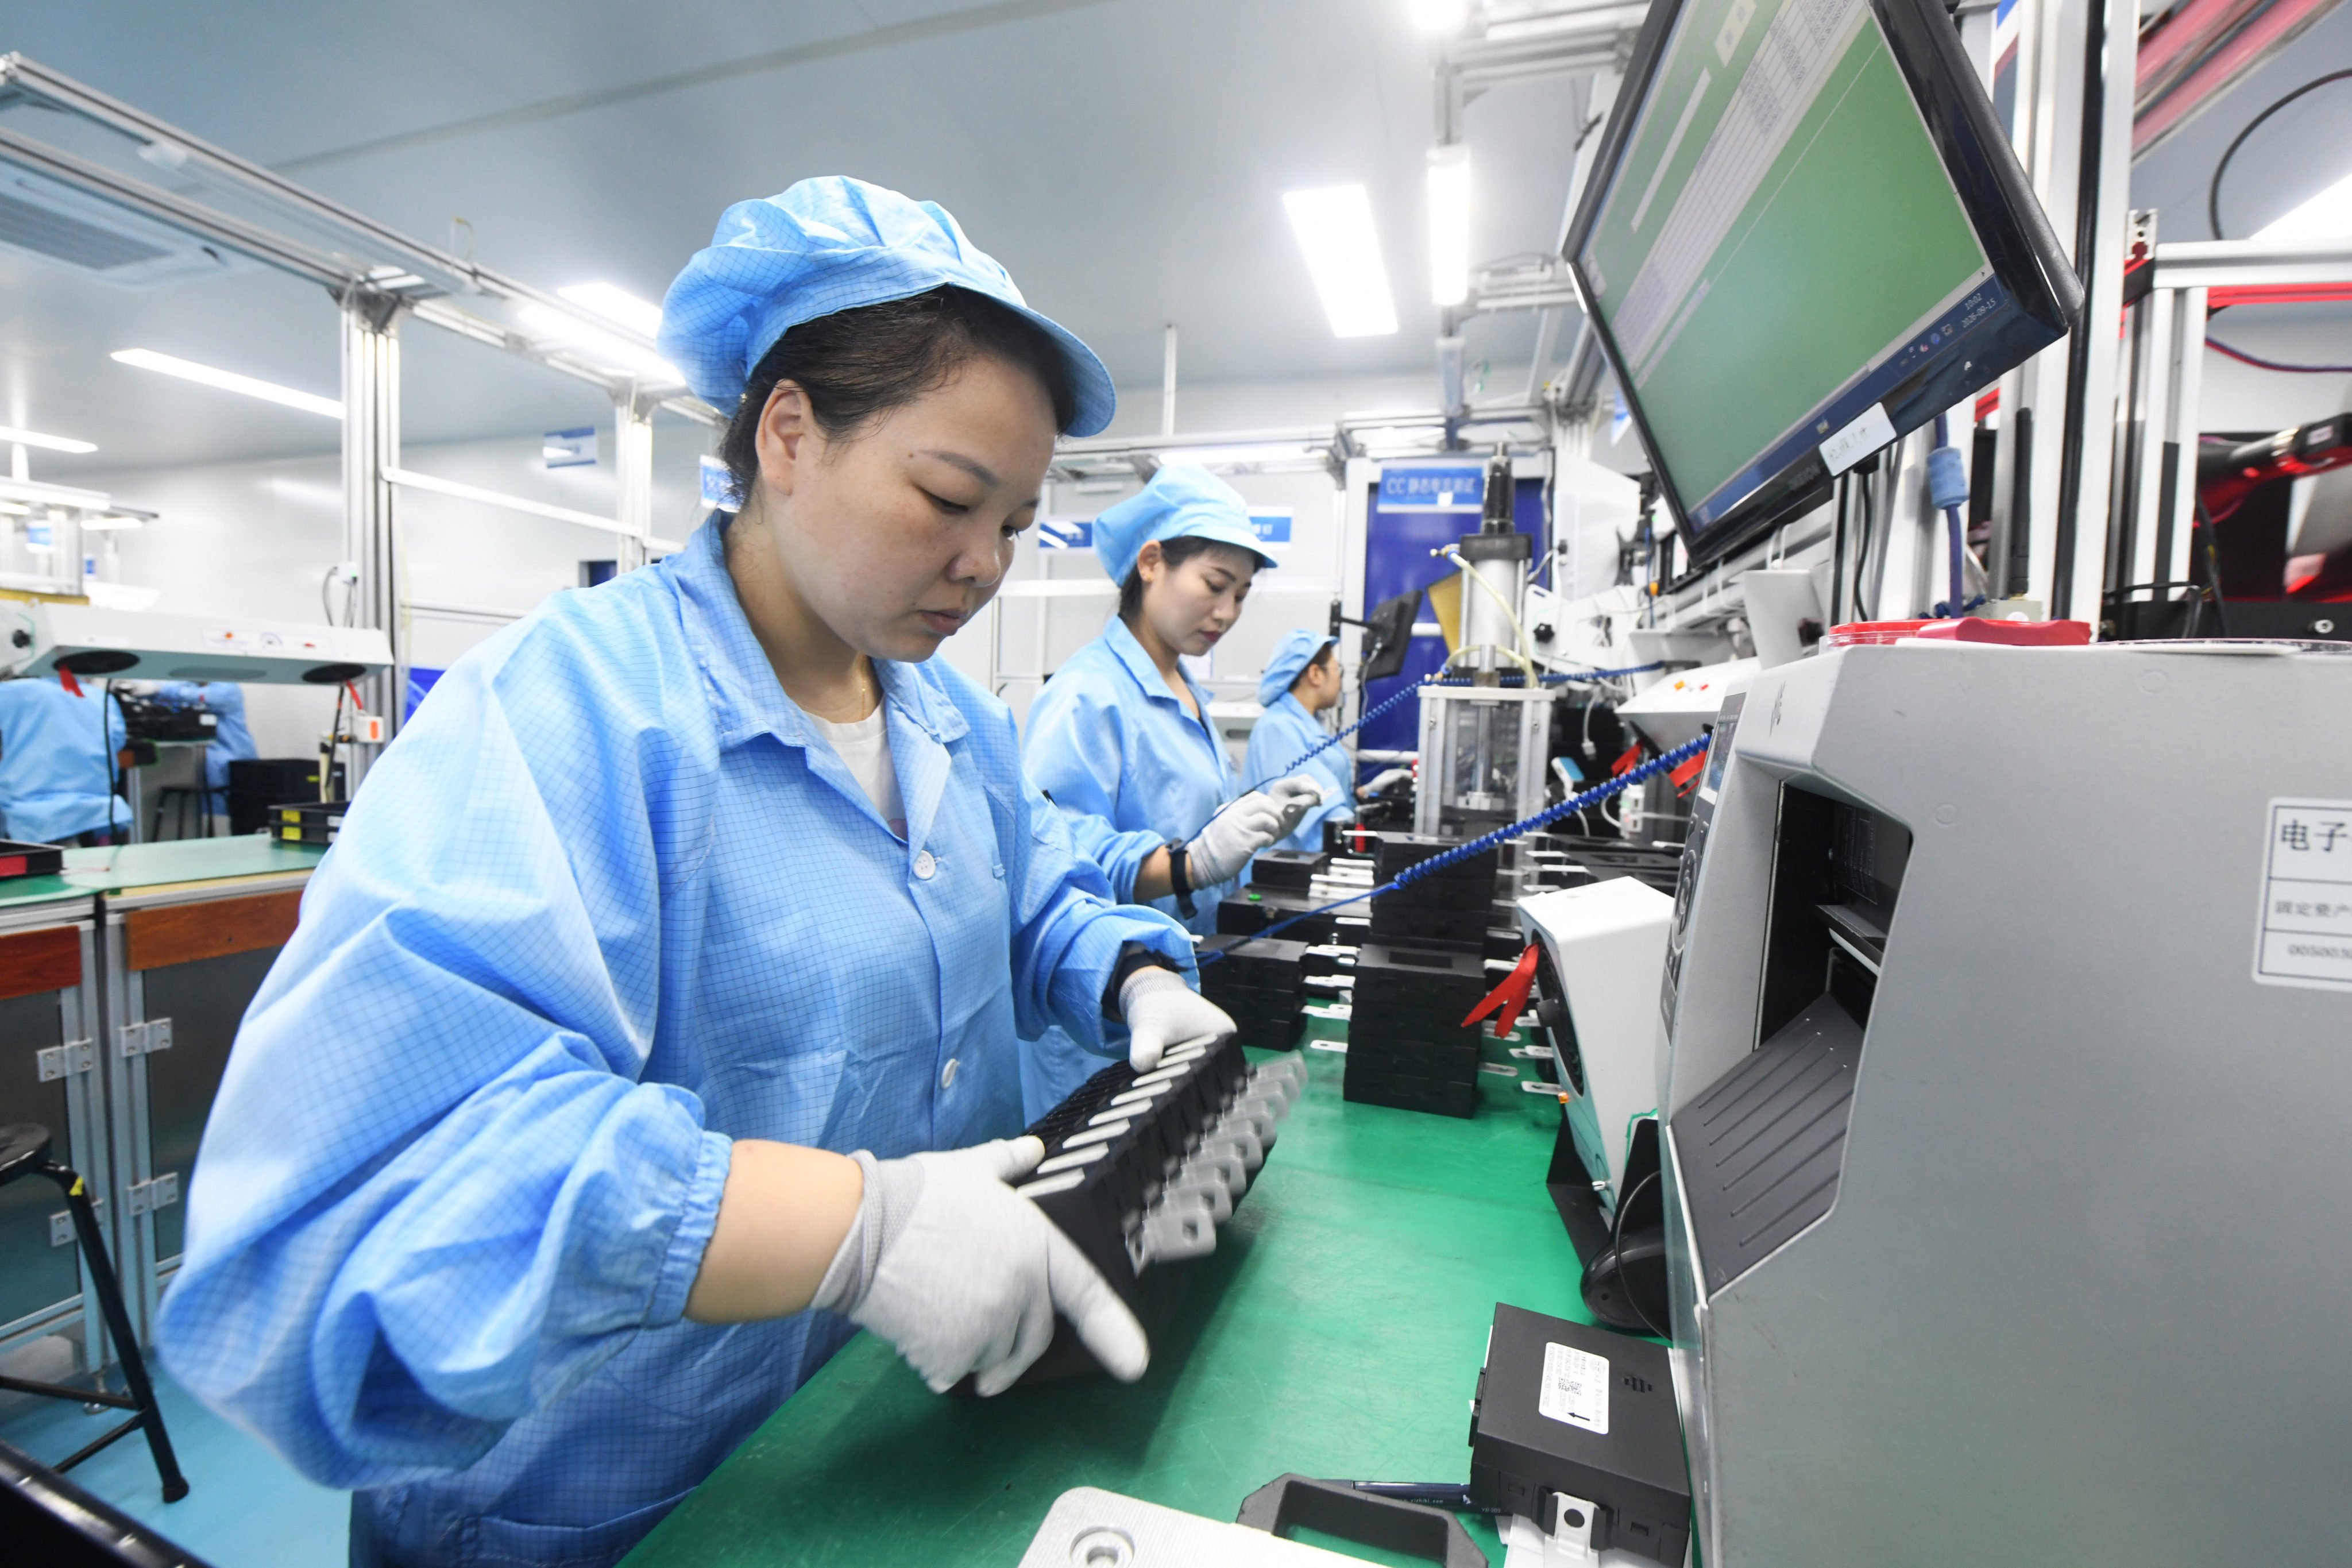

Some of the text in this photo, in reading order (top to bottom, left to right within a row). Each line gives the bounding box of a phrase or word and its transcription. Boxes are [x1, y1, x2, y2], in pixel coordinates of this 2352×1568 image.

[2281, 818, 2352, 852] 电子
[2275, 900, 2352, 917] 固定资产
